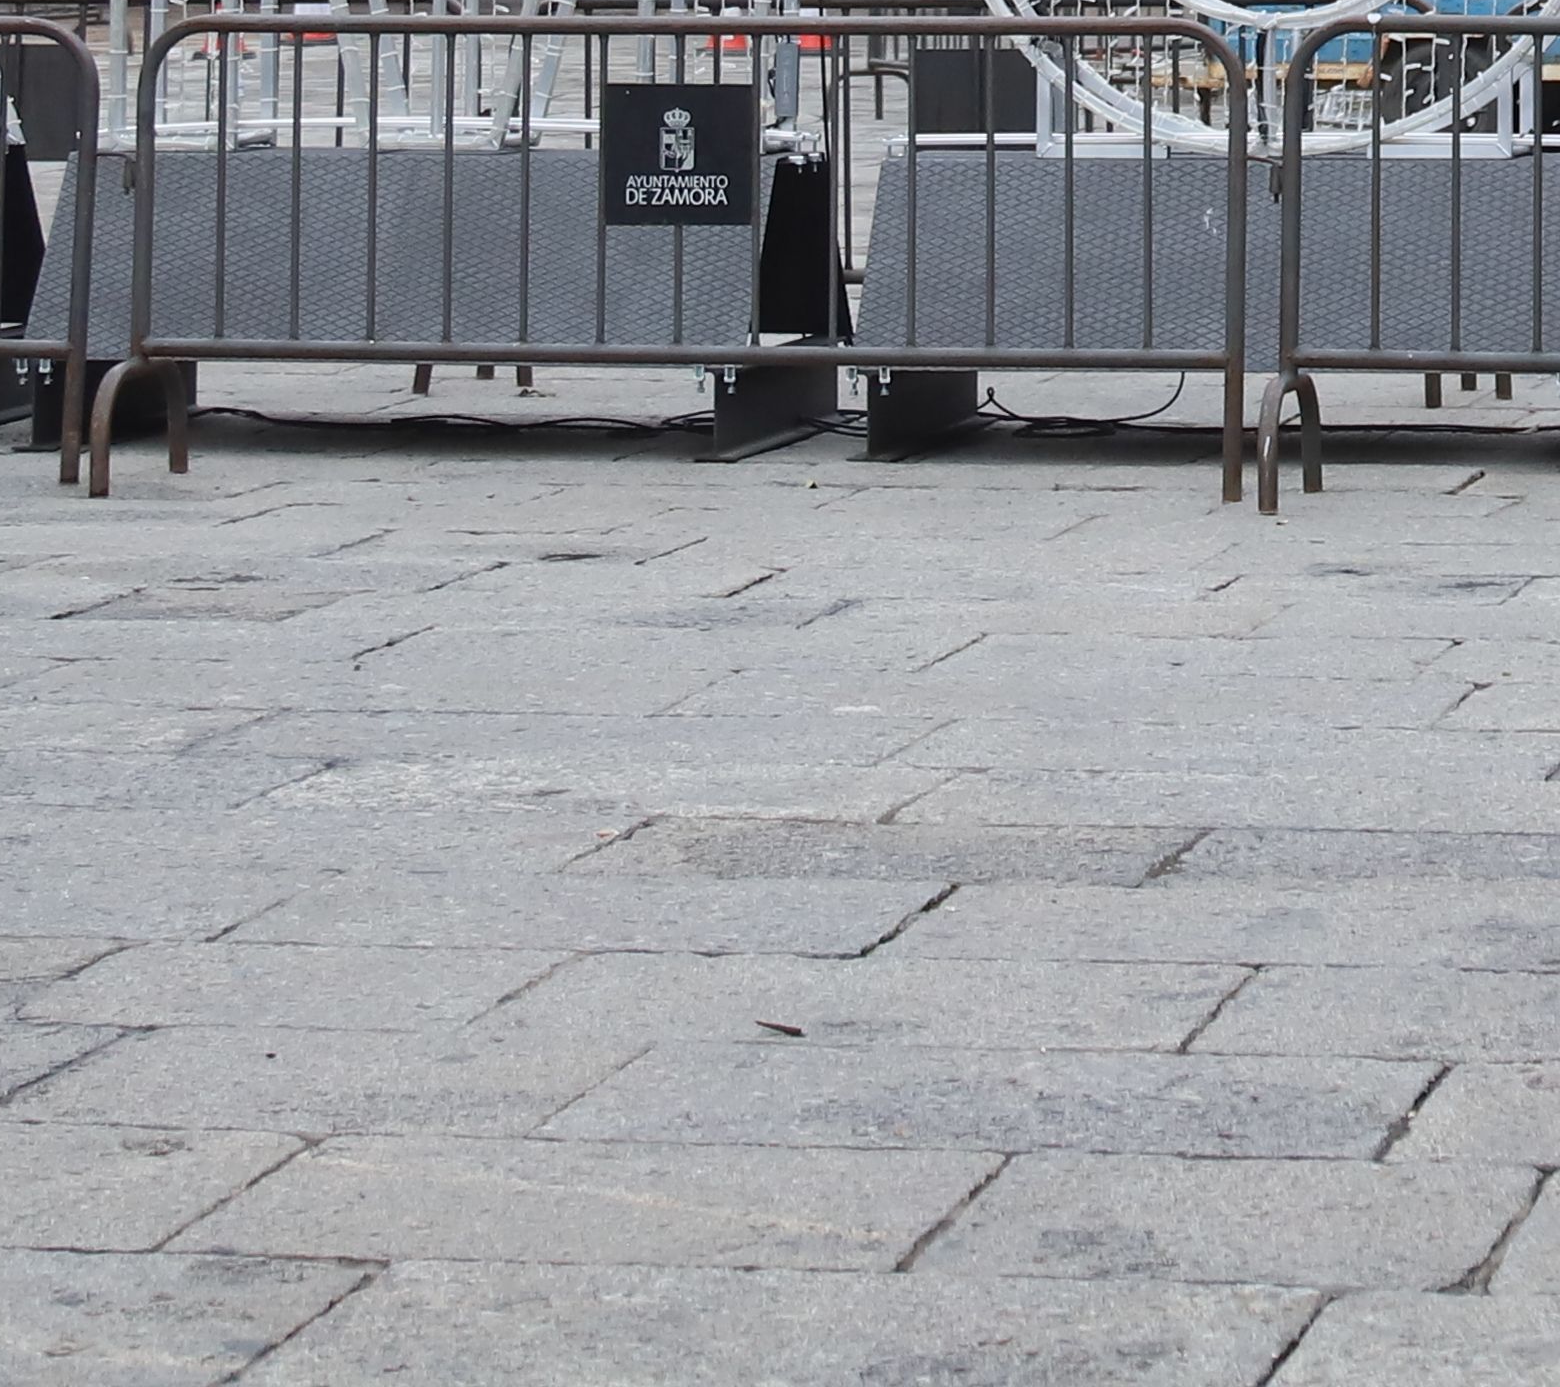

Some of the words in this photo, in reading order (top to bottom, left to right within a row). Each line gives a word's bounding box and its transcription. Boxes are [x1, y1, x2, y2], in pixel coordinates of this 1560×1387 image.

[626, 175, 728, 188] AYUNTAMIENTO
[625, 188, 647, 205] DE
[650, 188, 728, 205] ZAMORA
